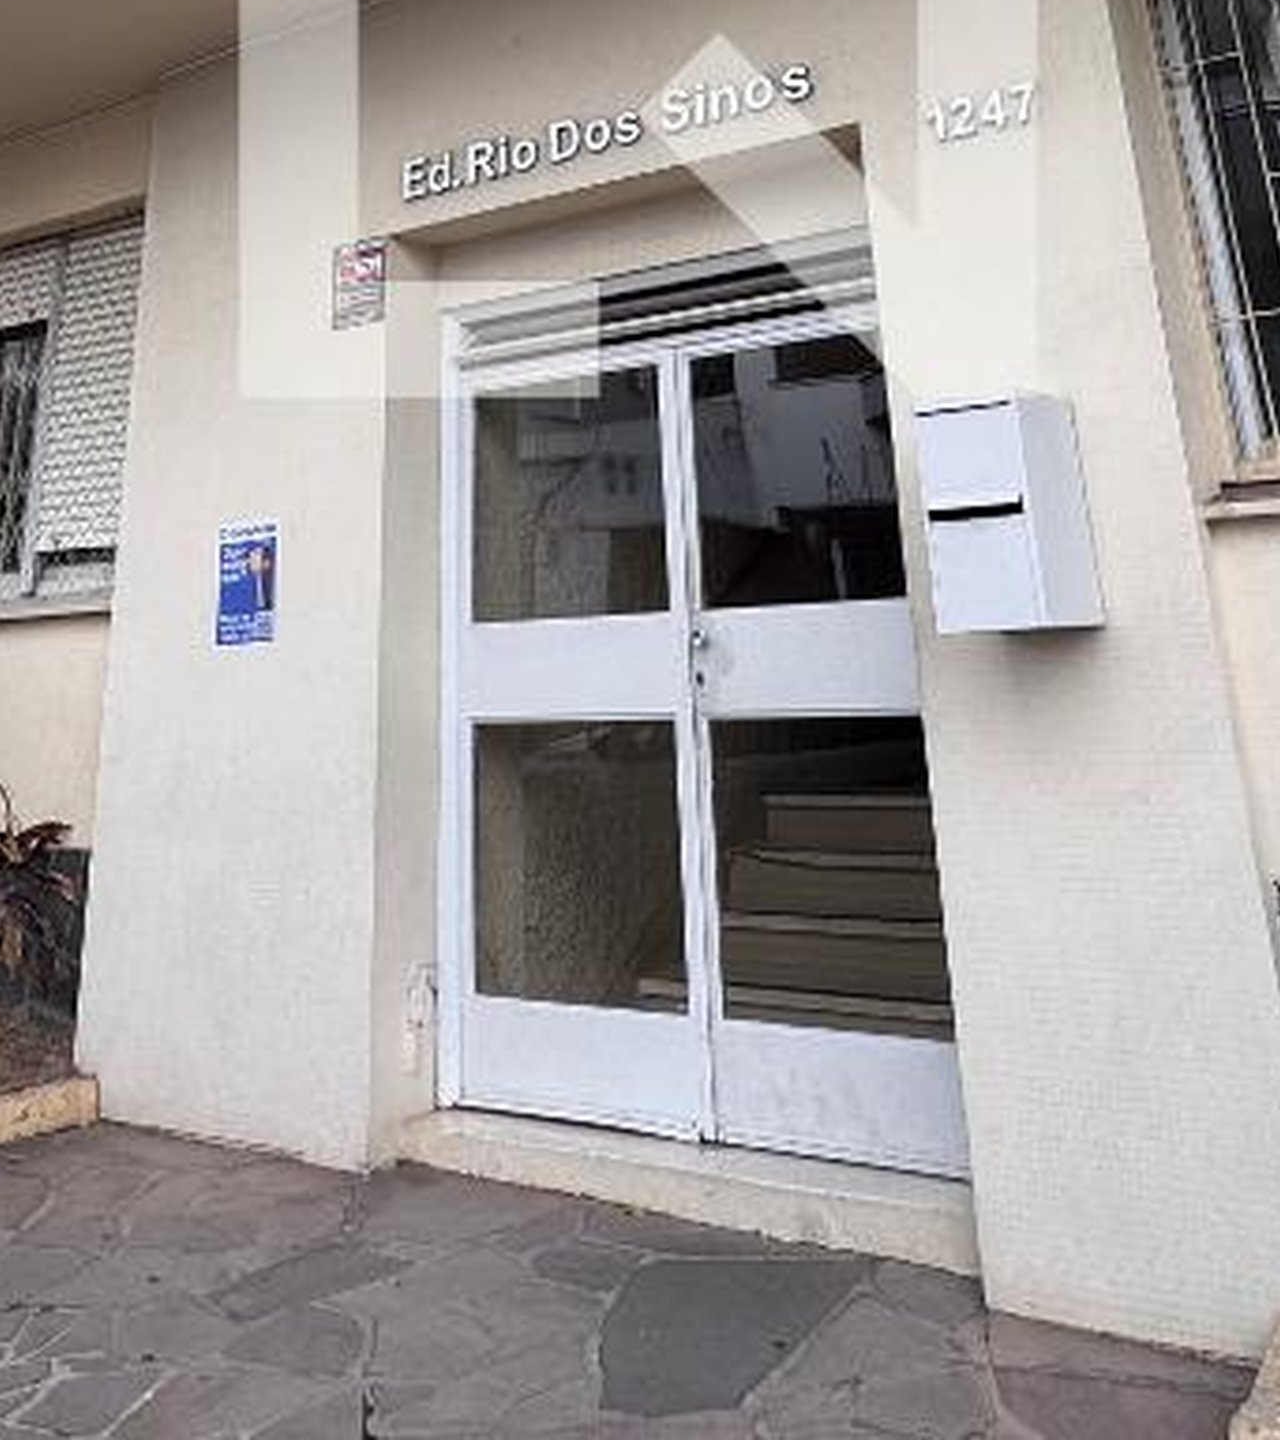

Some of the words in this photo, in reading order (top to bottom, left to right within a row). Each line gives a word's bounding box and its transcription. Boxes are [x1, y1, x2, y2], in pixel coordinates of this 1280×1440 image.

[549, 109, 643, 164] Dos
[660, 65, 812, 136] Sinos
[923, 84, 1034, 142] 1247
